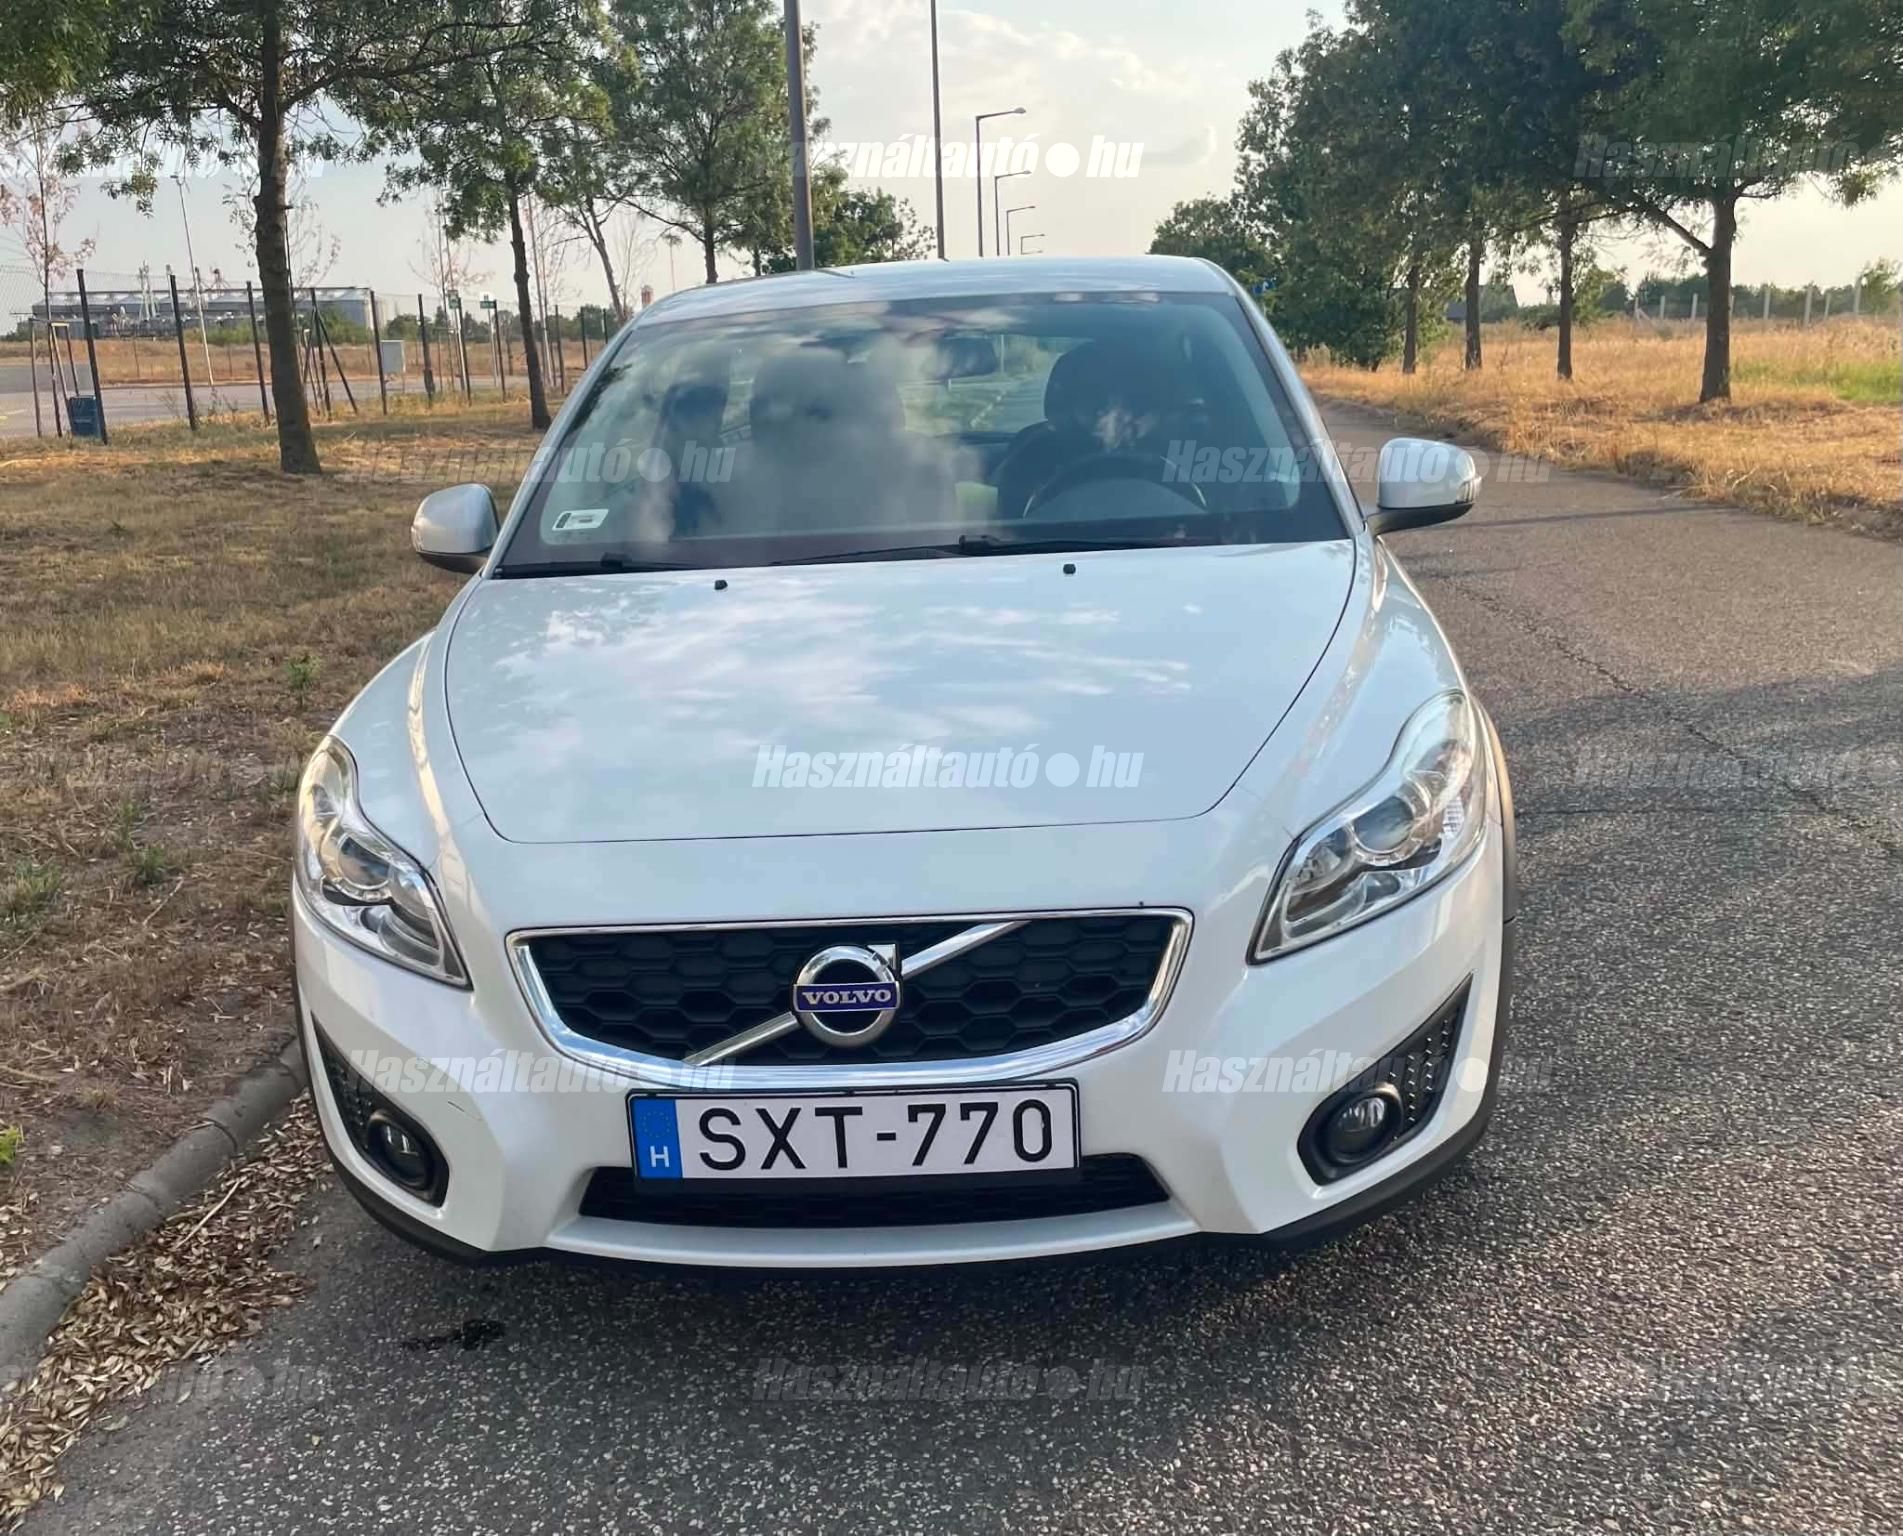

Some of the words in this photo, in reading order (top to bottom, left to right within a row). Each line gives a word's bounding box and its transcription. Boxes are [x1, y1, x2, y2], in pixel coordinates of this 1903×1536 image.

[802, 989, 892, 1005] VOLVO
[698, 1098, 1053, 1171] SXT-770
[649, 1145, 670, 1168] H
